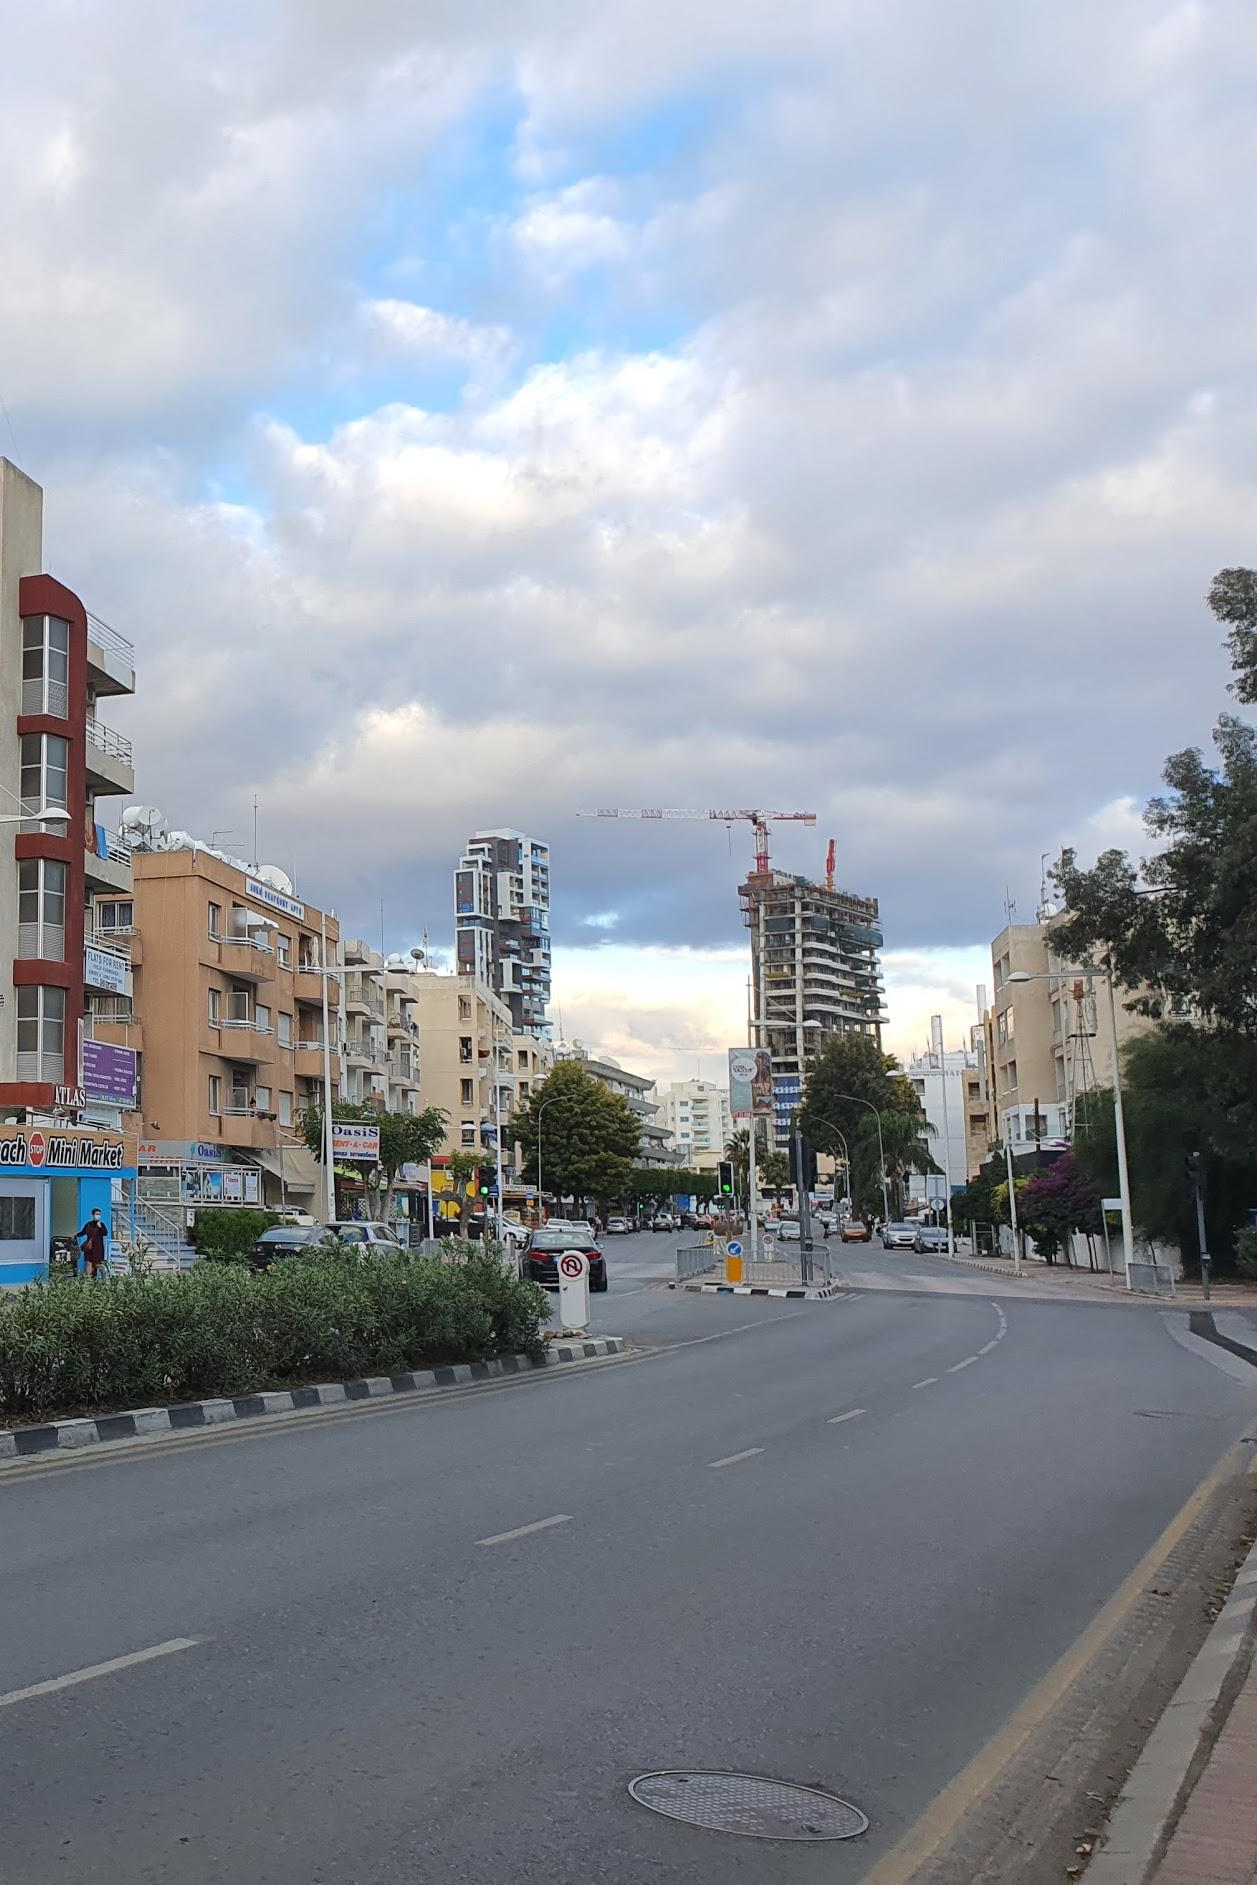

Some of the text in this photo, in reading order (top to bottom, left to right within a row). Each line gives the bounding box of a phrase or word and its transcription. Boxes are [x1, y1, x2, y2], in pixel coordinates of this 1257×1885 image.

[87, 951, 102, 965] FLATS
[103, 957, 113, 968] FOR
[55, 1086, 86, 1108] ATLAS
[30, 1144, 44, 1154] STOP
[46, 1136, 78, 1168] Mini
[78, 1138, 124, 1170] Market
[138, 1144, 157, 1153] AR
